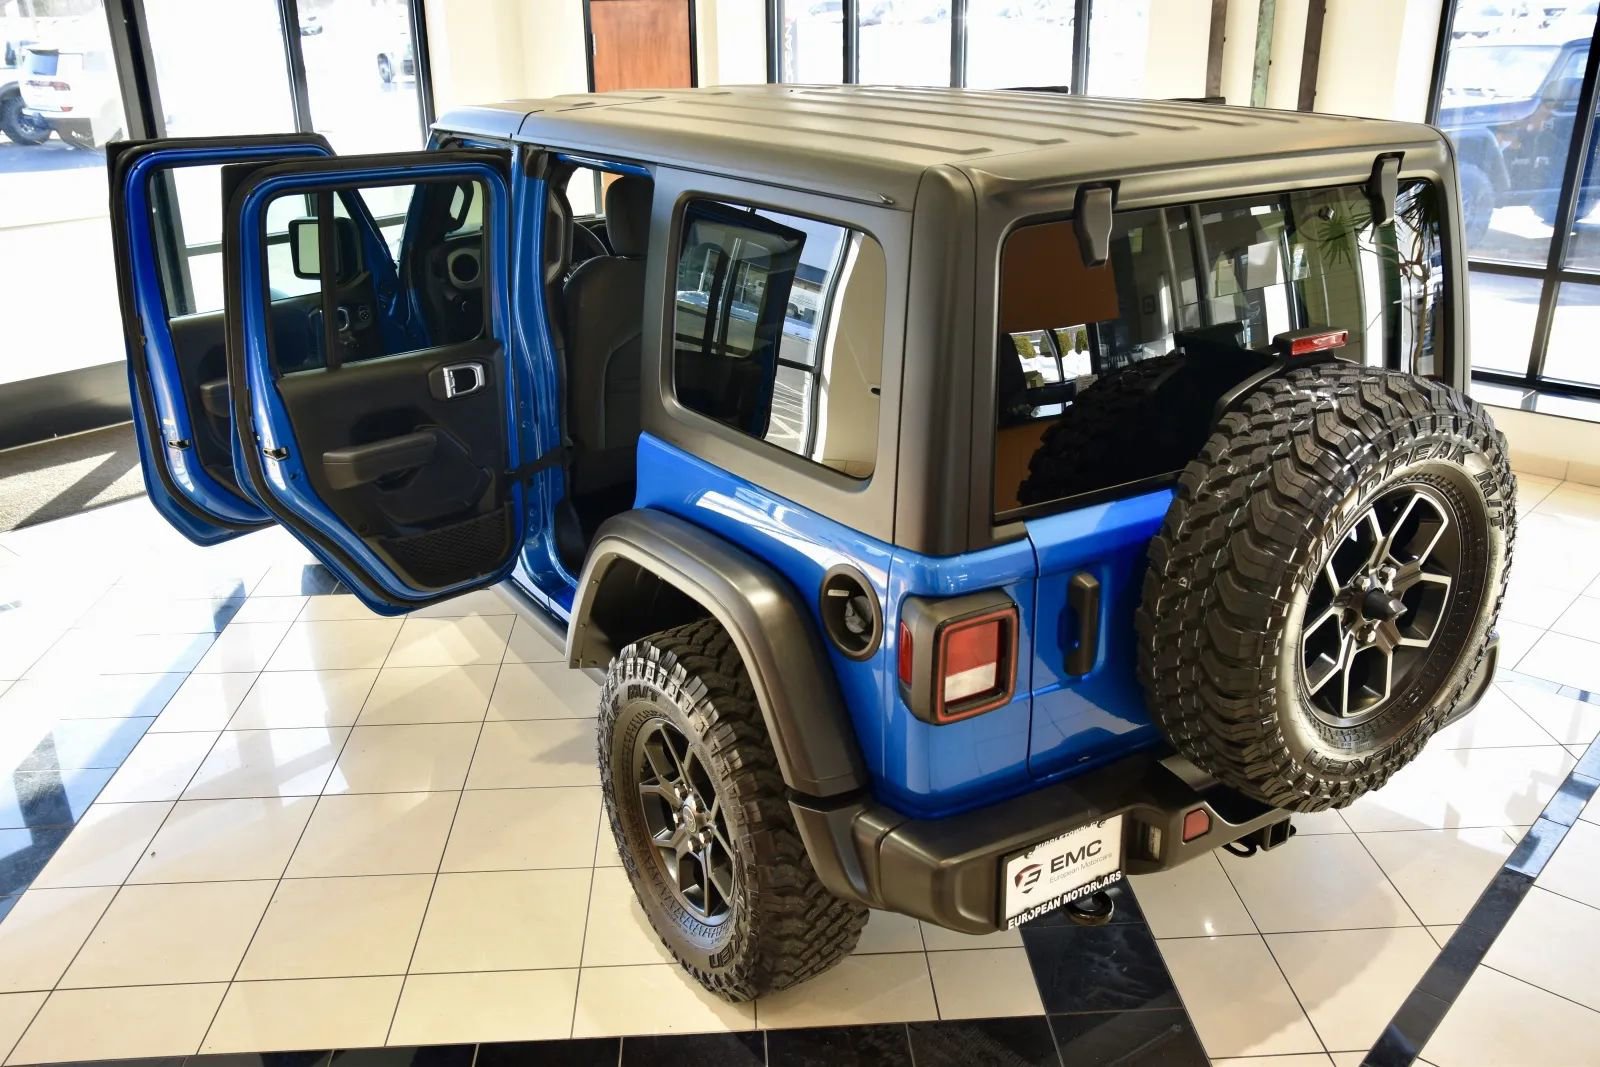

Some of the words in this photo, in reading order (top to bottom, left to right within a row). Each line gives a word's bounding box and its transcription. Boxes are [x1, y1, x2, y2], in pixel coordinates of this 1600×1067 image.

[1050, 839, 1102, 873] EMC
[1007, 895, 1061, 930] EUROPEAN
[1063, 870, 1122, 905] MOTORCARS
